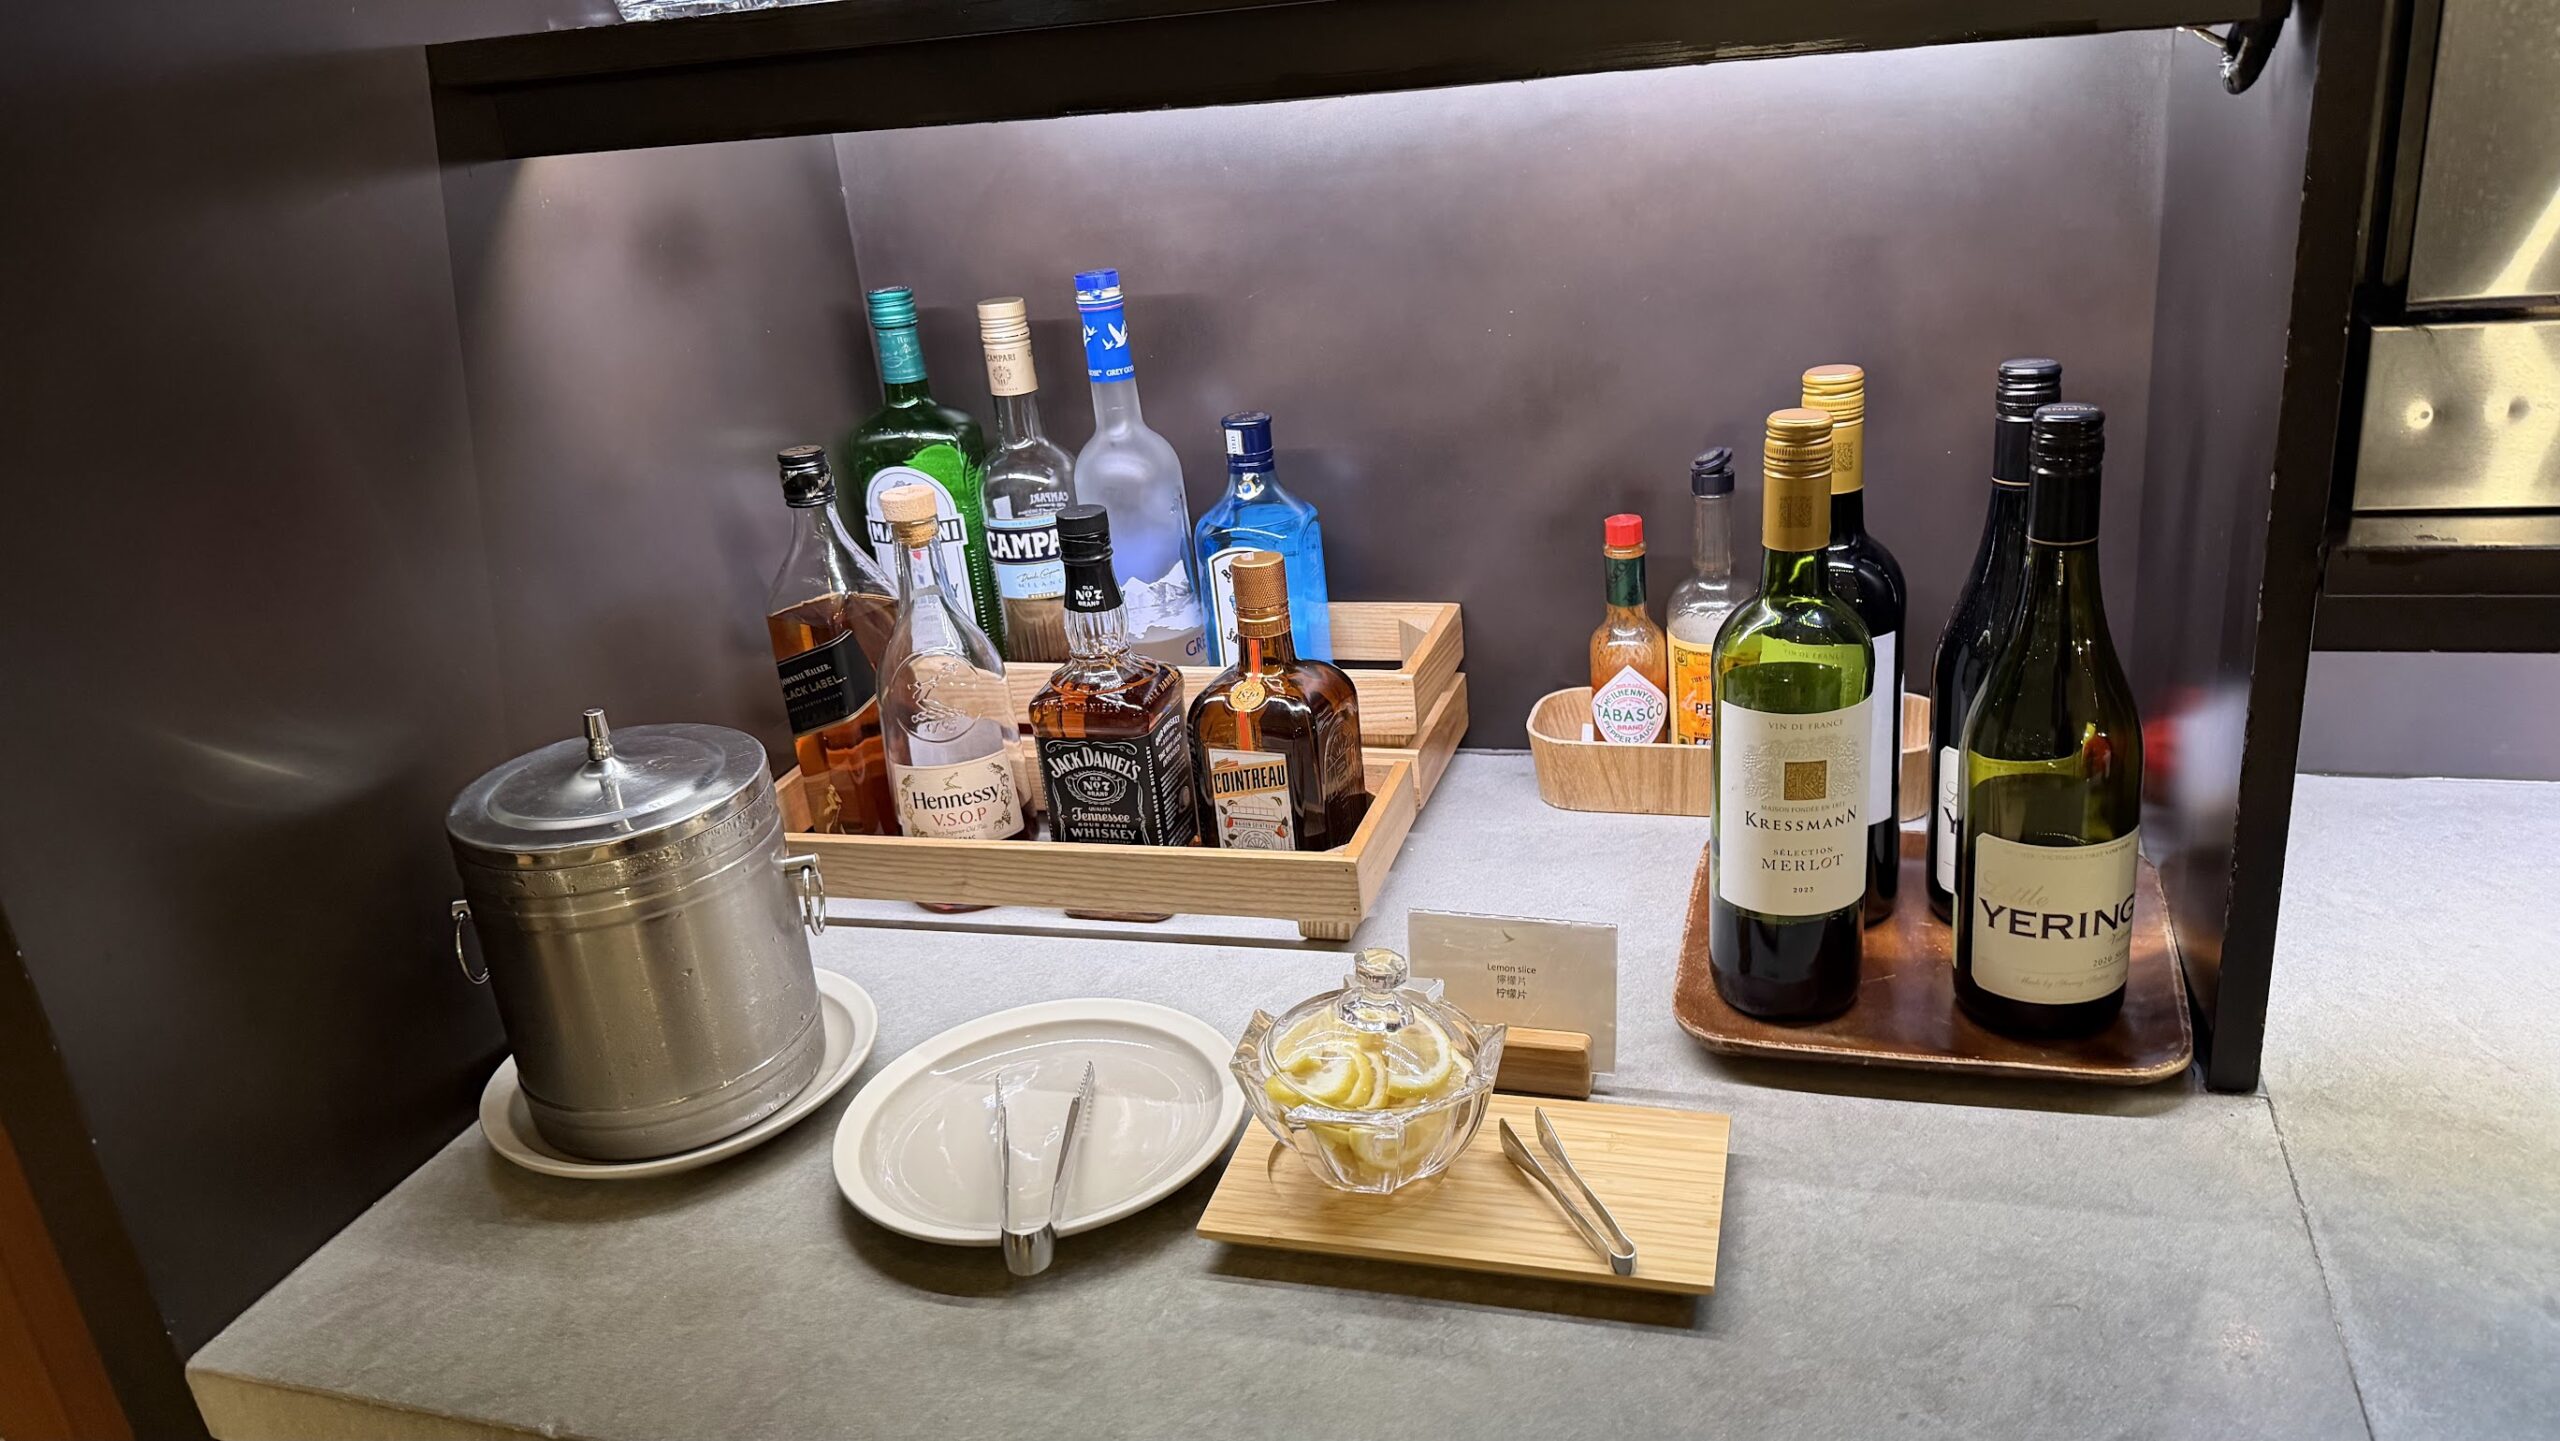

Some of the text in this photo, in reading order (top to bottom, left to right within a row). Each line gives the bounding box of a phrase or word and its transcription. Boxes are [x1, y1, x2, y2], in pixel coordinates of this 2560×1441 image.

[986, 353, 1016, 362] CAMPARI
[1106, 369, 1123, 377] GREY
[986, 528, 1060, 560] CAMPA
[784, 685, 808, 701] LACK
[1596, 702, 1664, 722] TABASCO
[1603, 720, 1656, 744] PEPPER SAUCE
[1768, 718, 1844, 730] VIN DE FRANCE
[1047, 746, 1141, 783] JACK DANIEL'S
[1212, 764, 1286, 794] COINTREAU
[911, 782, 1000, 811] Hennessy
[931, 806, 987, 827] V.S.O.P
[1071, 806, 1131, 823] Tennessee
[1761, 804, 1790, 813] MAISON
[1821, 803, 1831, 811] EN
[1744, 804, 1857, 832] KRESSMANN
[1070, 827, 1137, 840] WHISKEY
[1773, 846, 1834, 857] SÉLECTION
[1761, 853, 1844, 872] MERLOT
[1487, 963, 1537, 975] Lemon slice
[1496, 988, 1528, 1000] 柠檬片
